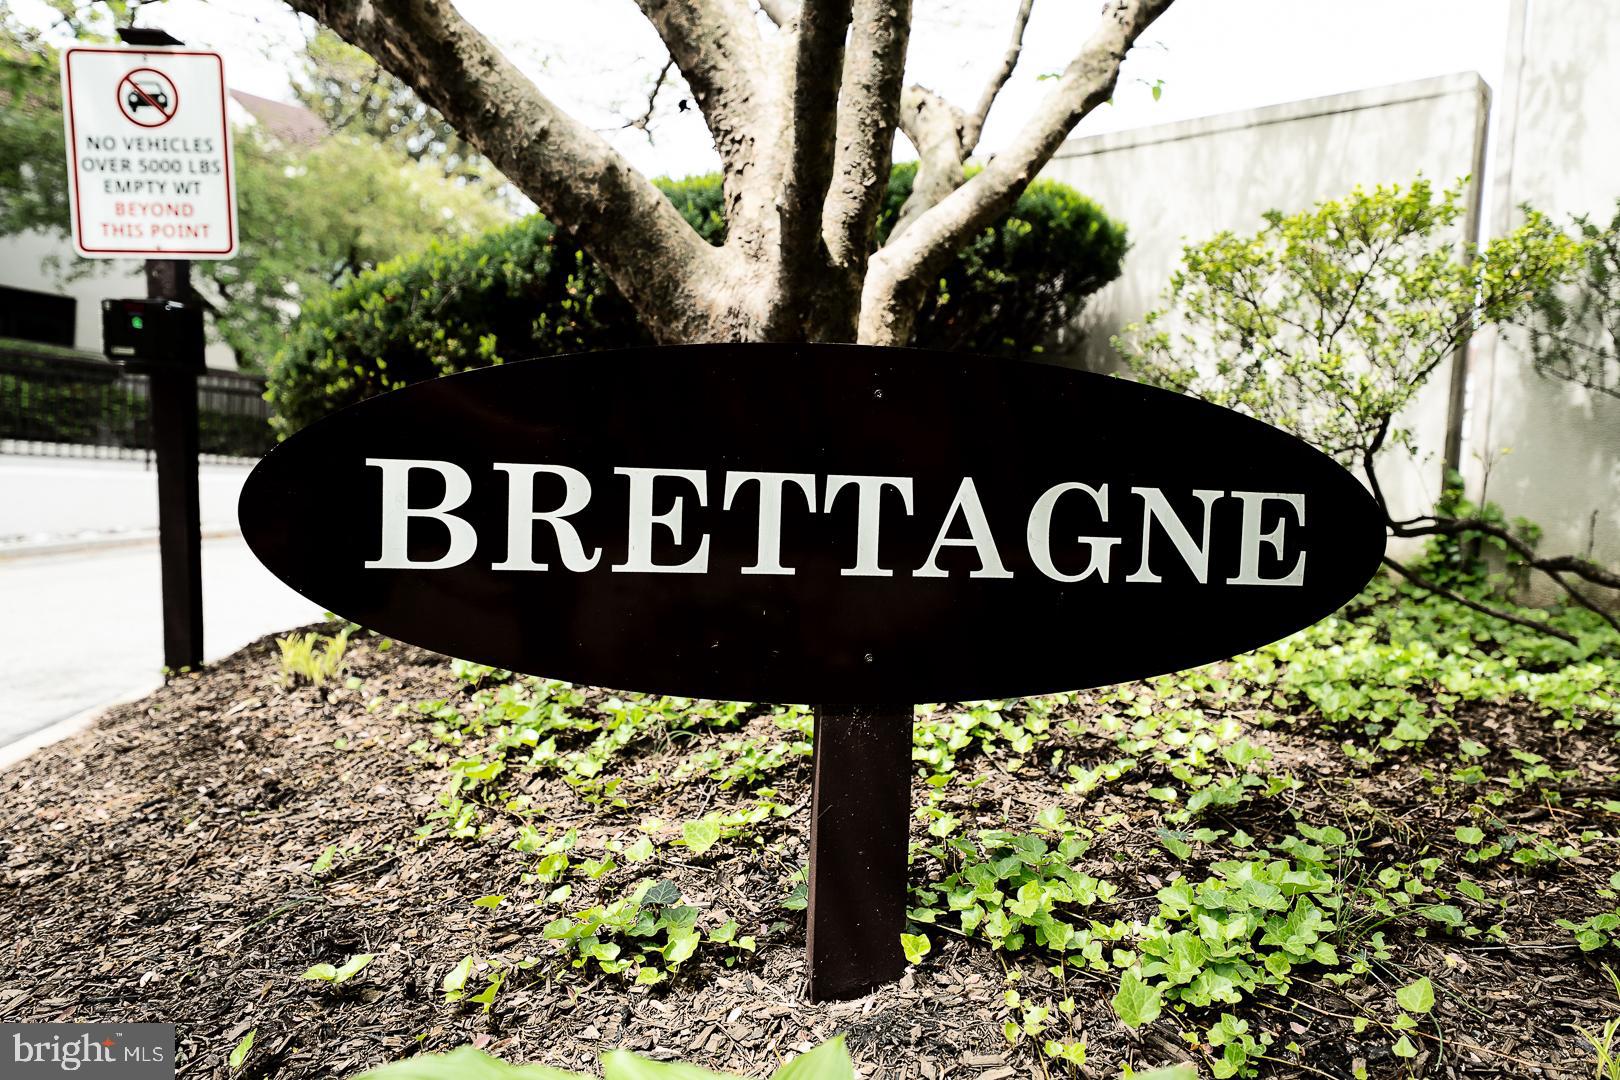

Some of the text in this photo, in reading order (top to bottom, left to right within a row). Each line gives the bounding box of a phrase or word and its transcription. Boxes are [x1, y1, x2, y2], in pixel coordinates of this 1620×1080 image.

[86, 137, 214, 153] NO VEHICLES
[81, 158, 221, 175] OVER 5000 LBS
[104, 180, 201, 195] EMPTY WT
[115, 202, 194, 218] BEYOND
[101, 223, 210, 239] THIS POINT
[365, 458, 1306, 586] BRETTAGNE
